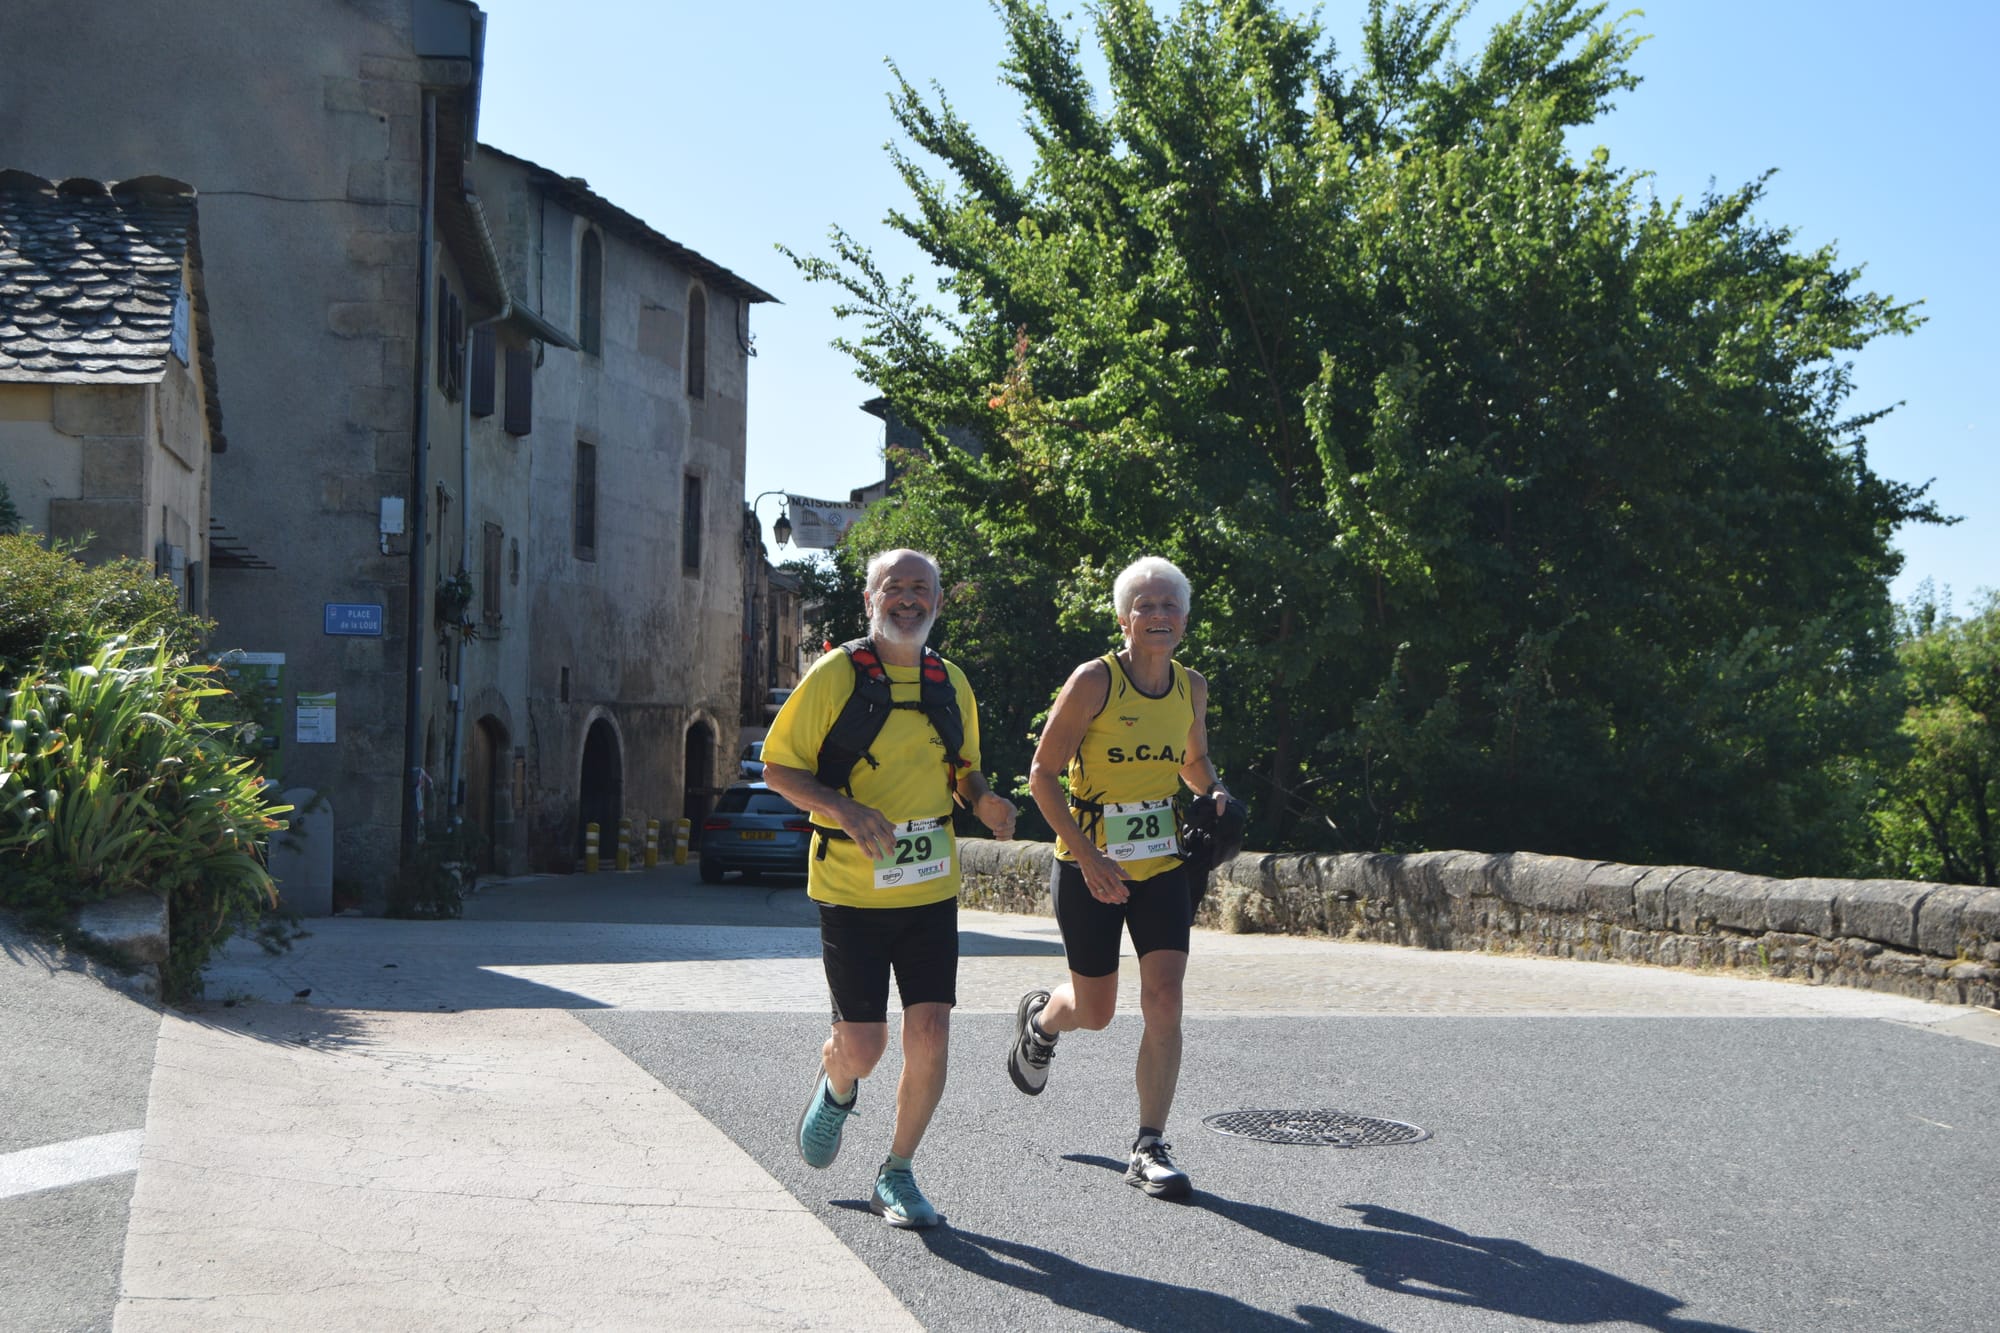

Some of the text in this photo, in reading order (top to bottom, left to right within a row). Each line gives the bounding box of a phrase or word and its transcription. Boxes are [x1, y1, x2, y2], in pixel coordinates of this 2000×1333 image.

[347, 610, 371, 618] PLACE
[1126, 814, 1160, 841] 28
[894, 835, 932, 865] 29
